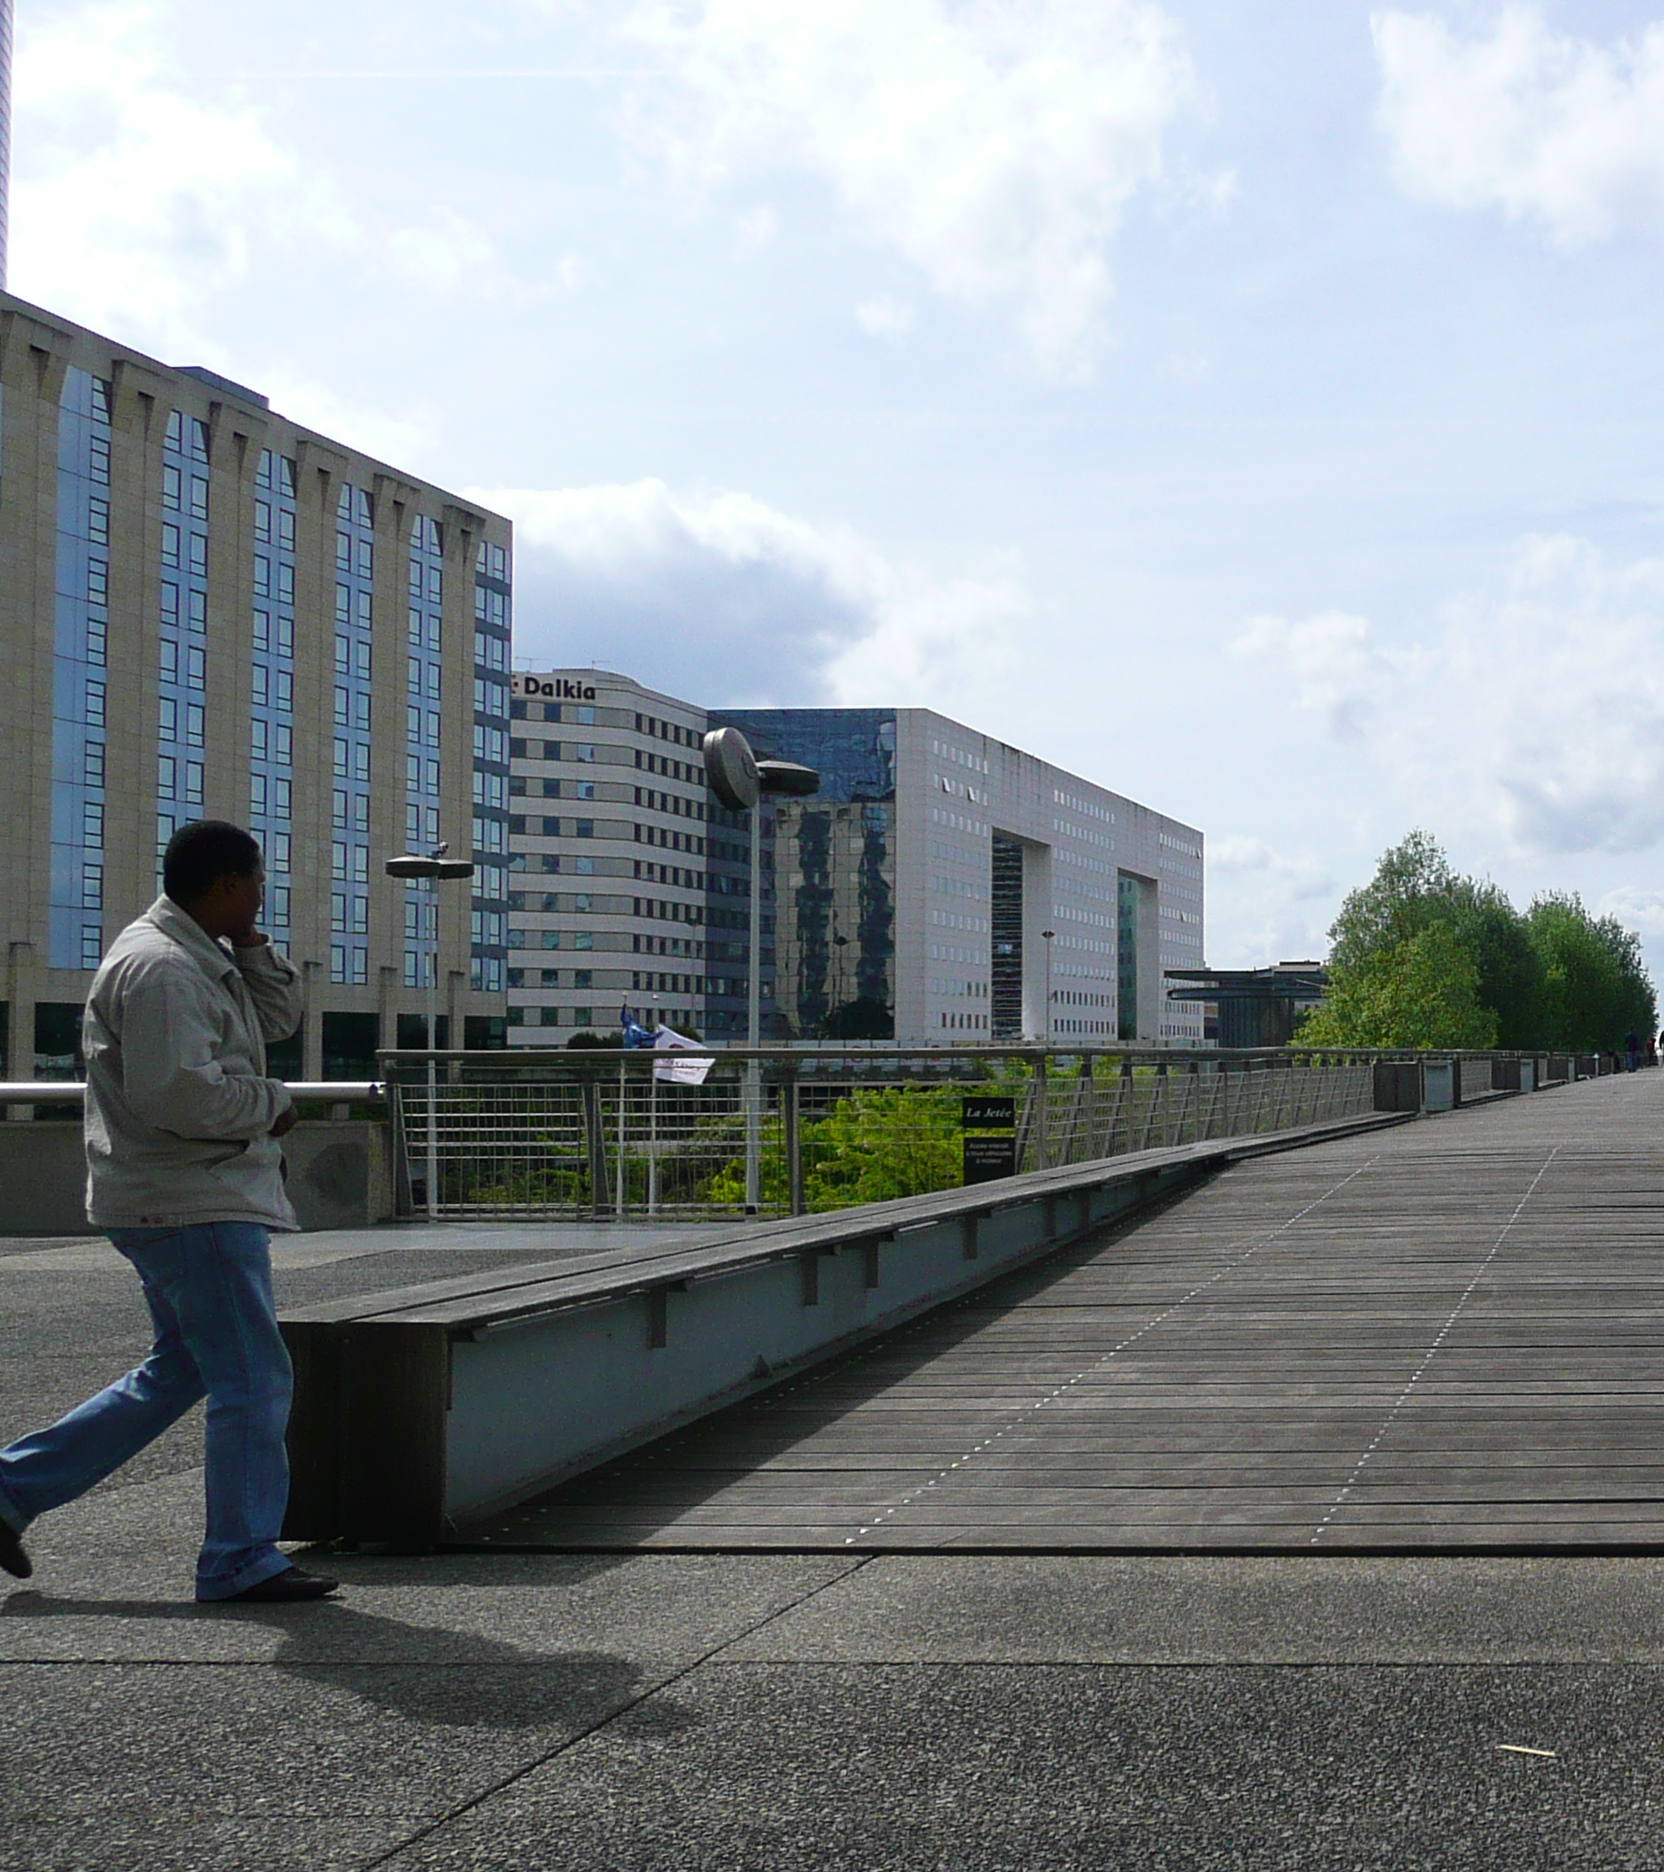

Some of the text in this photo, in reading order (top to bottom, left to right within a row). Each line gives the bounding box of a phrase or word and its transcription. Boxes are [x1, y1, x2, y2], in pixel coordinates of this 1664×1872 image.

[524, 676, 596, 700] Dalkia
[966, 1107, 1012, 1118] La Jetée
